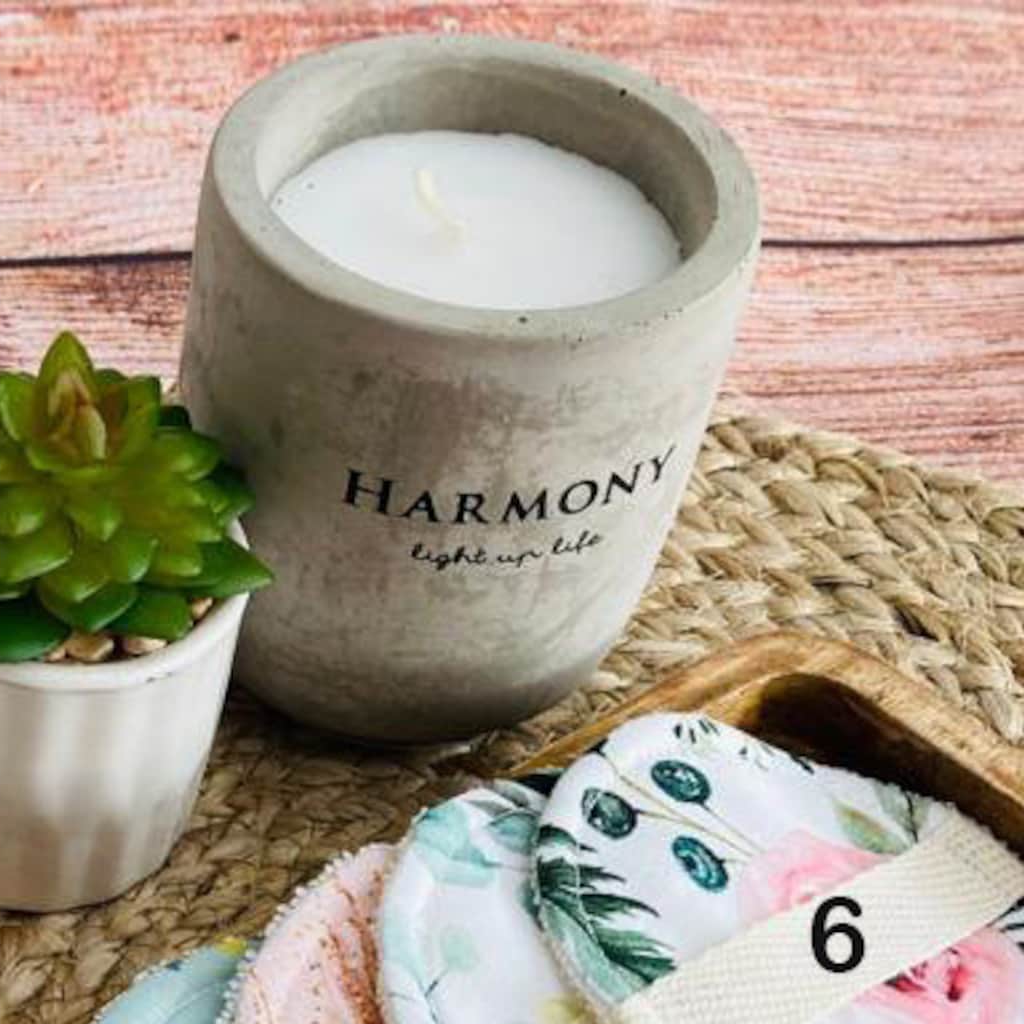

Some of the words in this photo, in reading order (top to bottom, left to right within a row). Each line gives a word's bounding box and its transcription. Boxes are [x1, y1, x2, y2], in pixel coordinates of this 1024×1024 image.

[343, 444, 676, 524] HARMONY
[410, 542, 487, 570] light
[497, 549, 543, 568] up
[551, 530, 604, 556] life
